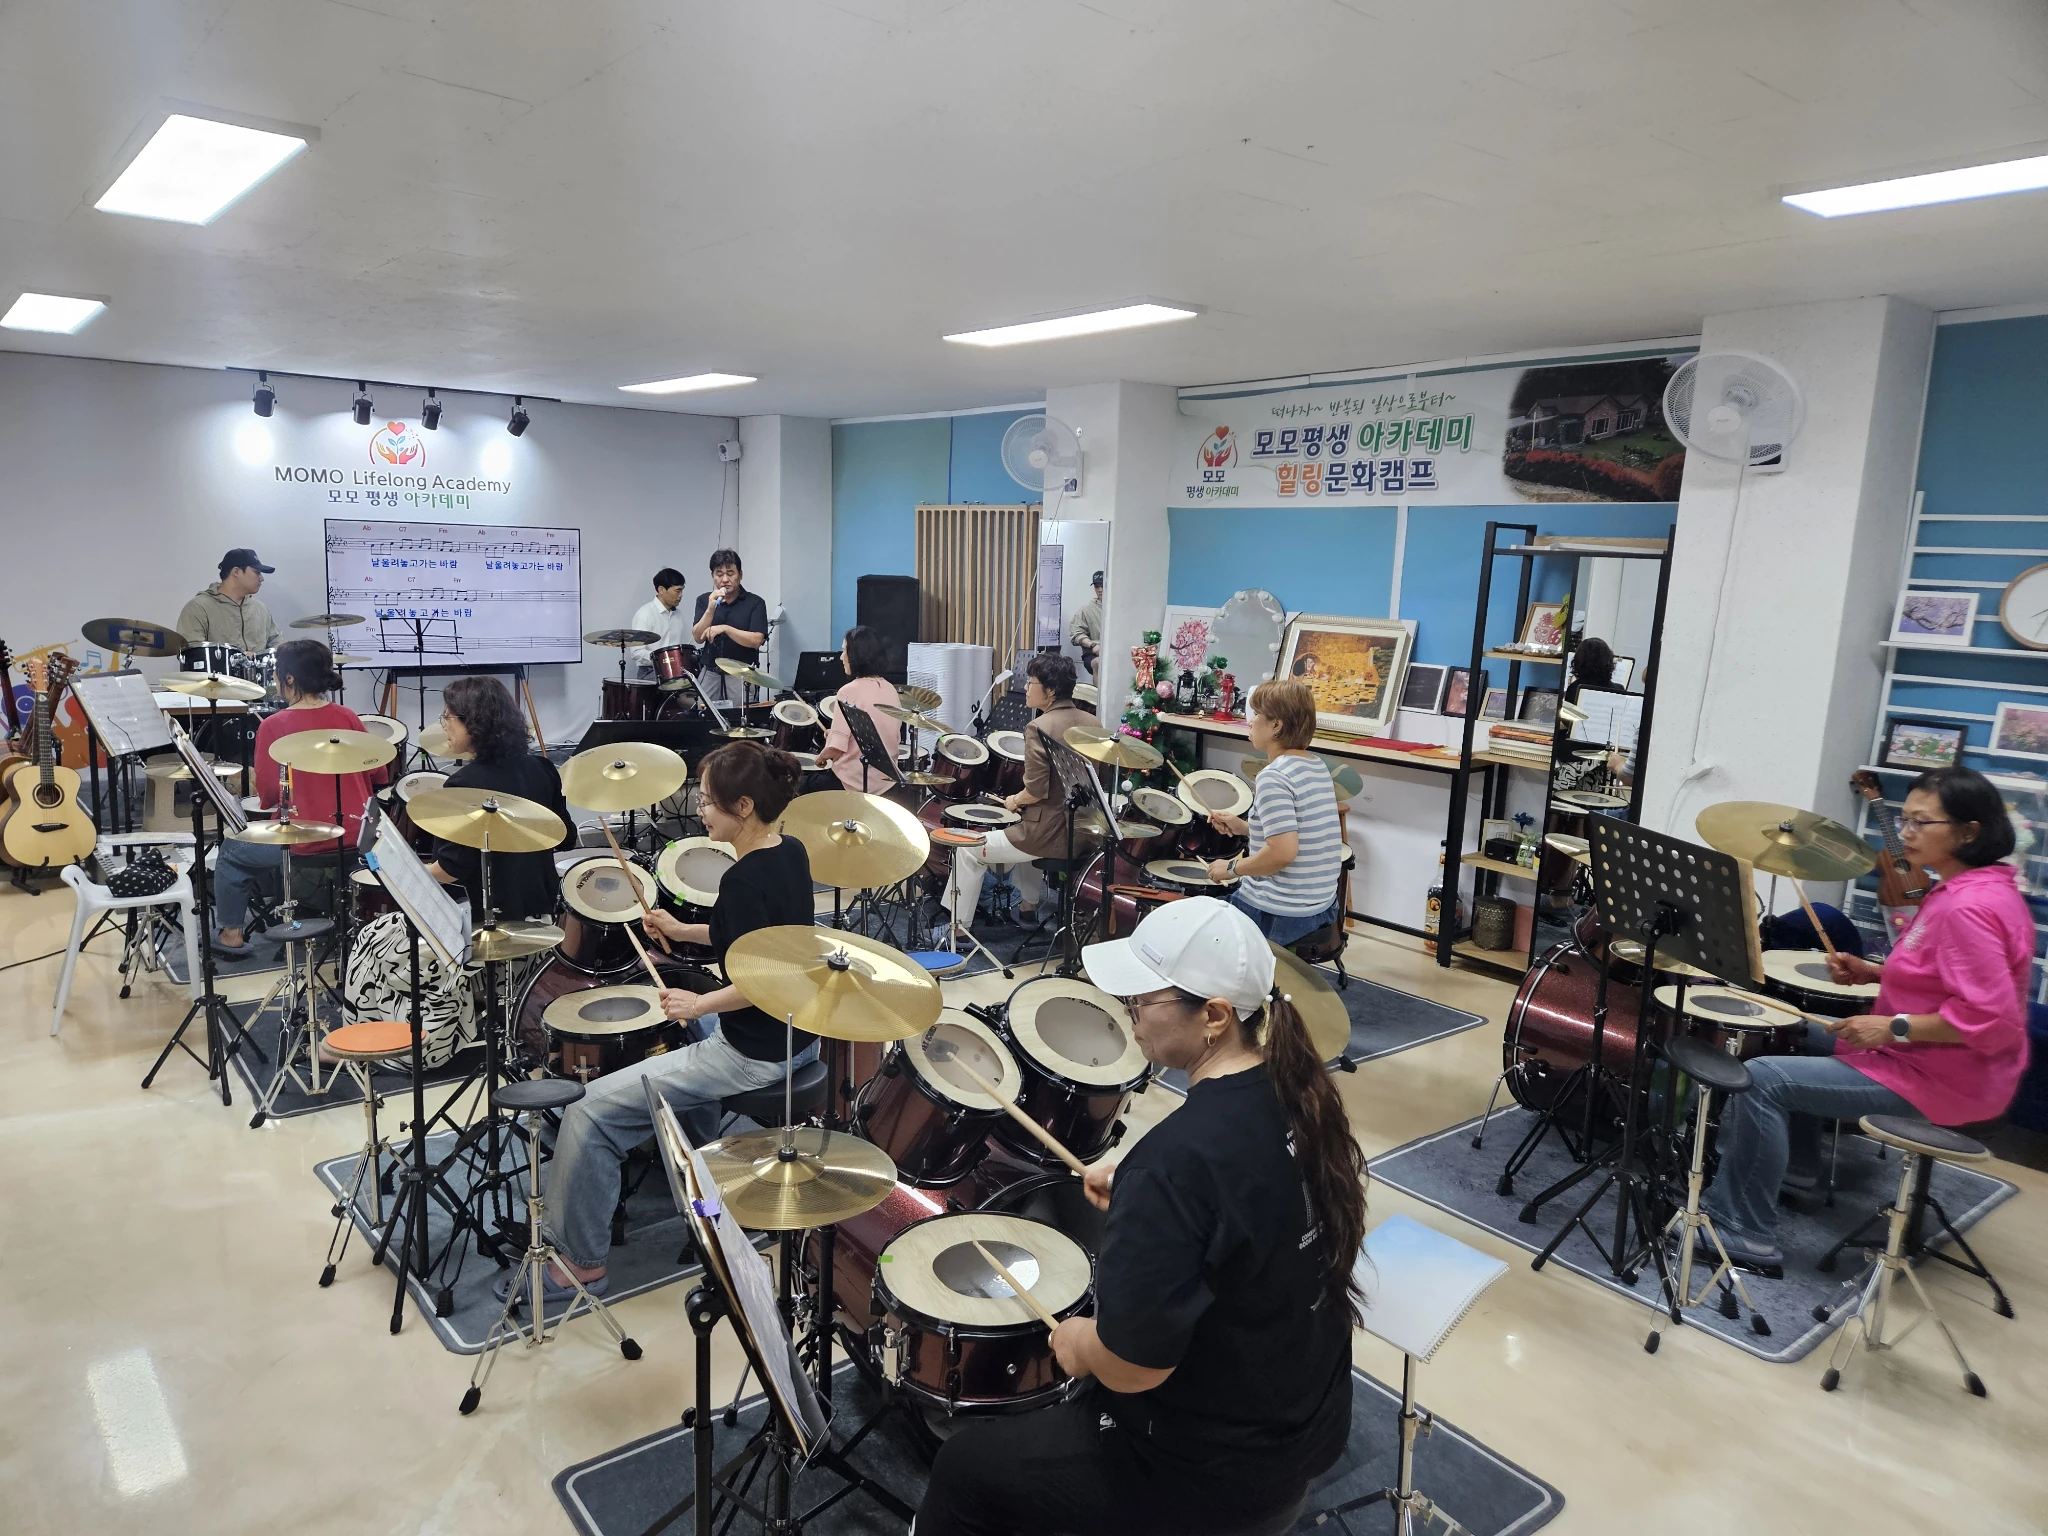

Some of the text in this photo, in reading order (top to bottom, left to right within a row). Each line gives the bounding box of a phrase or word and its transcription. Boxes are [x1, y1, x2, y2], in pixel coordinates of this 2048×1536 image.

[1271, 390, 1456, 418] 떠나자~ 반복된 일상으로부터~
[1255, 414, 1473, 457] 모모평생 아카데미
[274, 466, 511, 494] MOMO Lifelong Academy
[1202, 470, 1226, 483] 모모
[1277, 458, 1437, 495] 힐링문화캠프
[327, 489, 471, 509] 모모 평생 아카데미
[1186, 485, 1239, 499] 평생 아카데미
